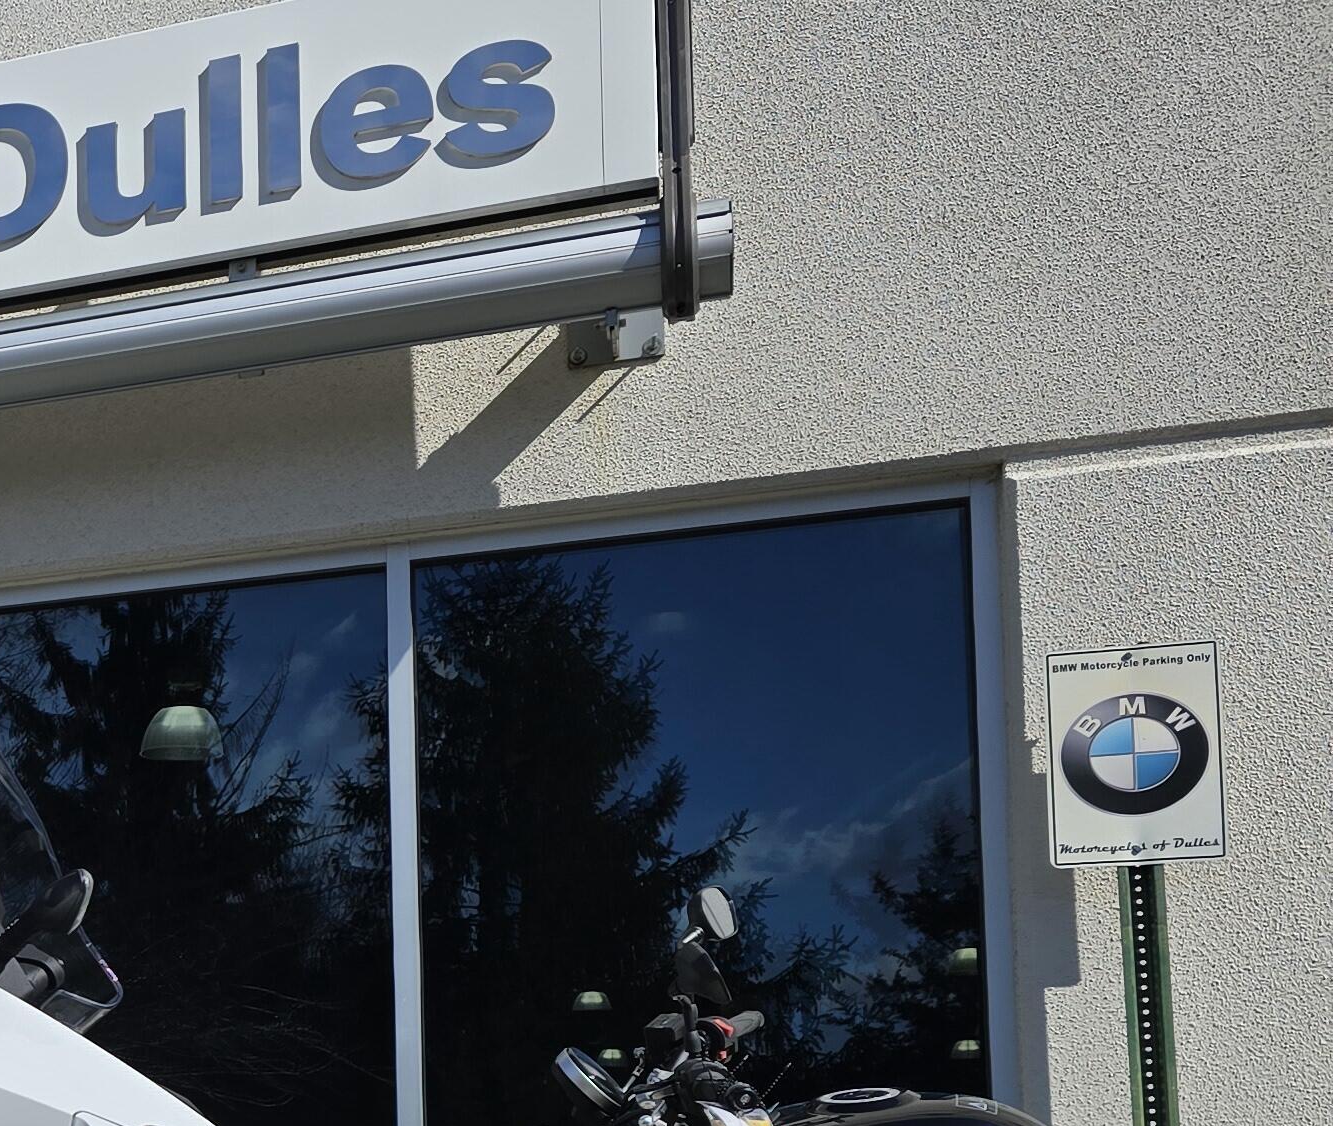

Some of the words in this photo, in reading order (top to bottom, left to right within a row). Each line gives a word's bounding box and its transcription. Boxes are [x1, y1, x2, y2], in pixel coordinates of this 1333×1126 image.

[1052, 662, 1078, 673] BMW
[1080, 658, 1139, 671] Motorcycle
[1143, 655, 1184, 667] Parking
[1187, 652, 1212, 664] Only
[1073, 696, 1197, 738] BMW
[1173, 837, 1221, 850] Dulles
